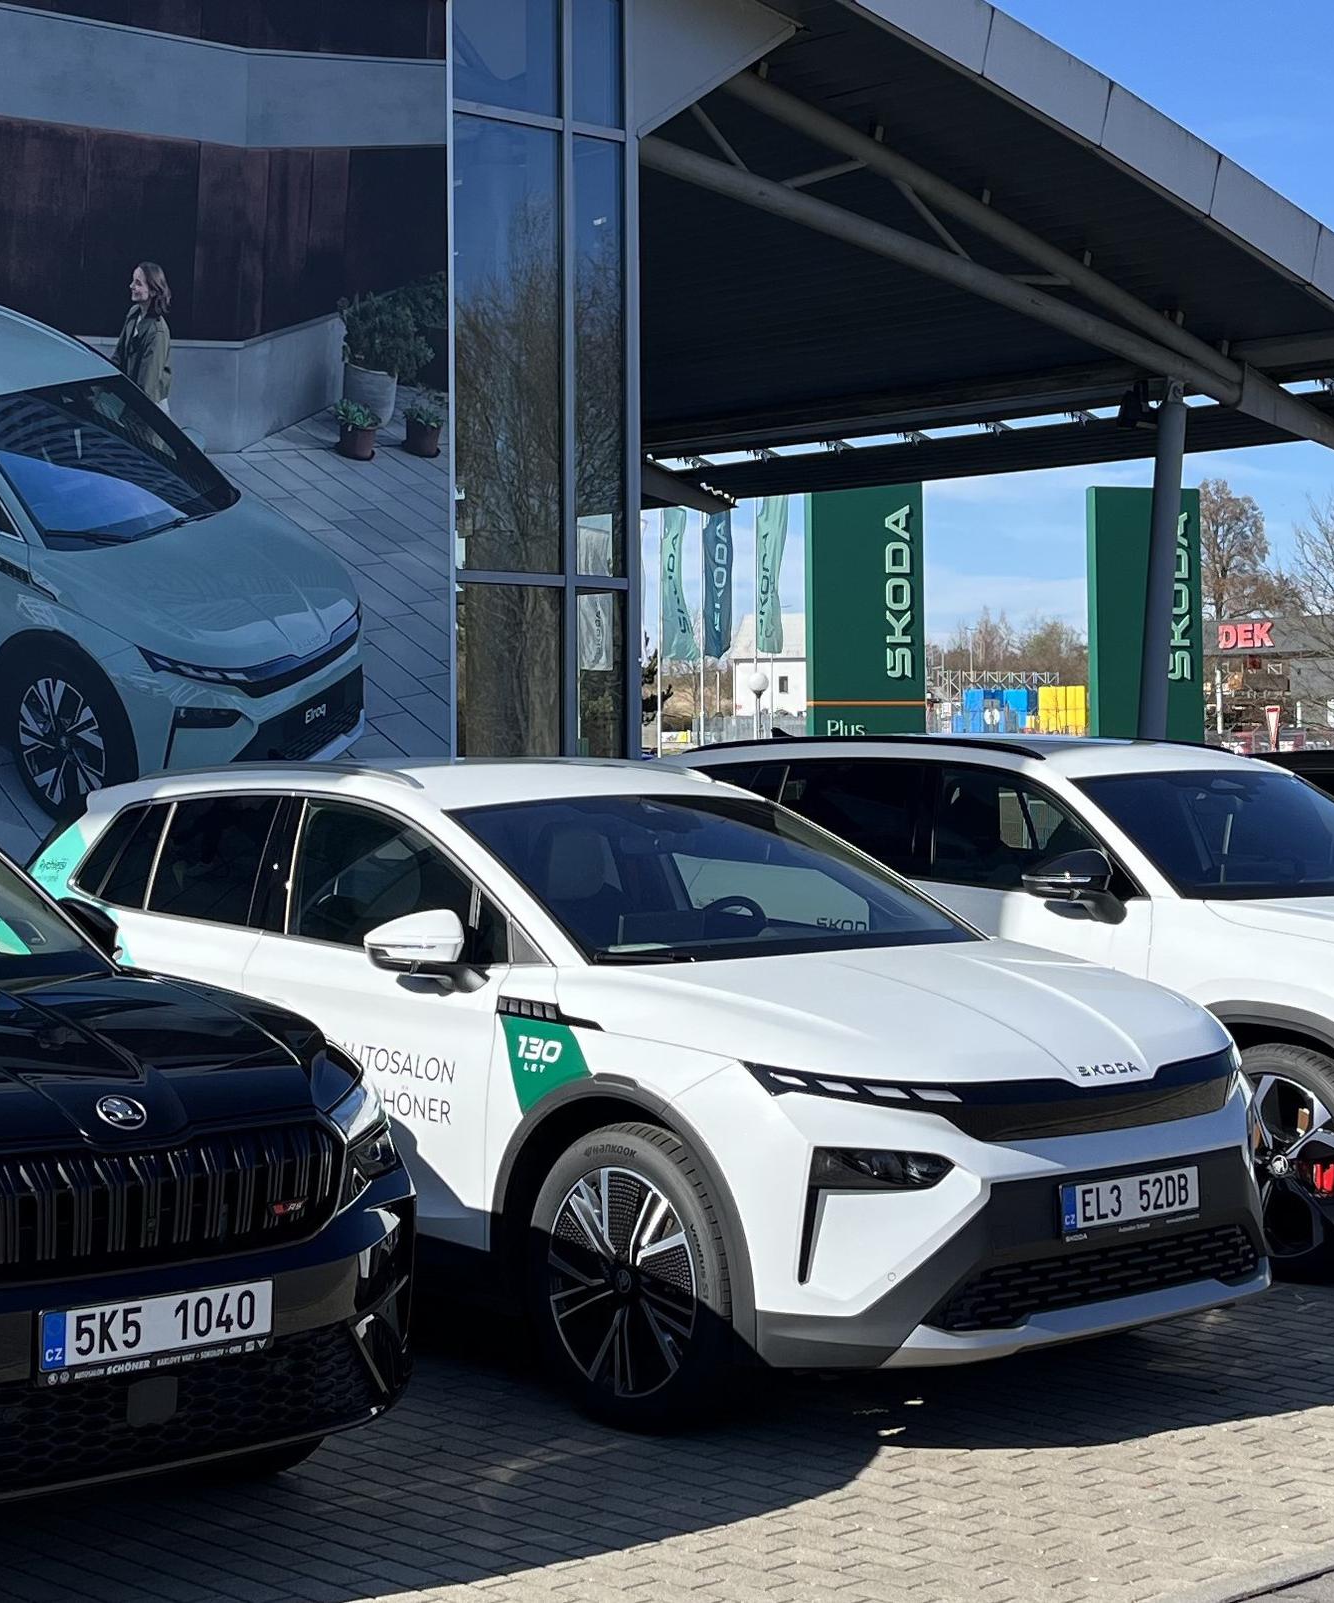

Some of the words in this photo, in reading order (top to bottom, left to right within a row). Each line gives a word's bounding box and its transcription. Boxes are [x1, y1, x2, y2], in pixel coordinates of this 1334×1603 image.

[1218, 622, 1274, 649] DEK
[305, 703, 327, 724] Elroq
[827, 719, 866, 736] Plus
[517, 1035, 563, 1064] 130
[344, 1043, 456, 1085] UTOSALON
[522, 1062, 546, 1074] LET
[382, 1084, 452, 1126] HÖNER
[1081, 1184, 1122, 1223] EL3
[1138, 1173, 1190, 1212] 52DB
[1064, 1214, 1076, 1226] CZ
[75, 1306, 143, 1356] 5K5
[174, 1289, 255, 1341] 1040
[45, 1347, 63, 1362] CZ
[106, 1359, 151, 1376] SCHÖNER
